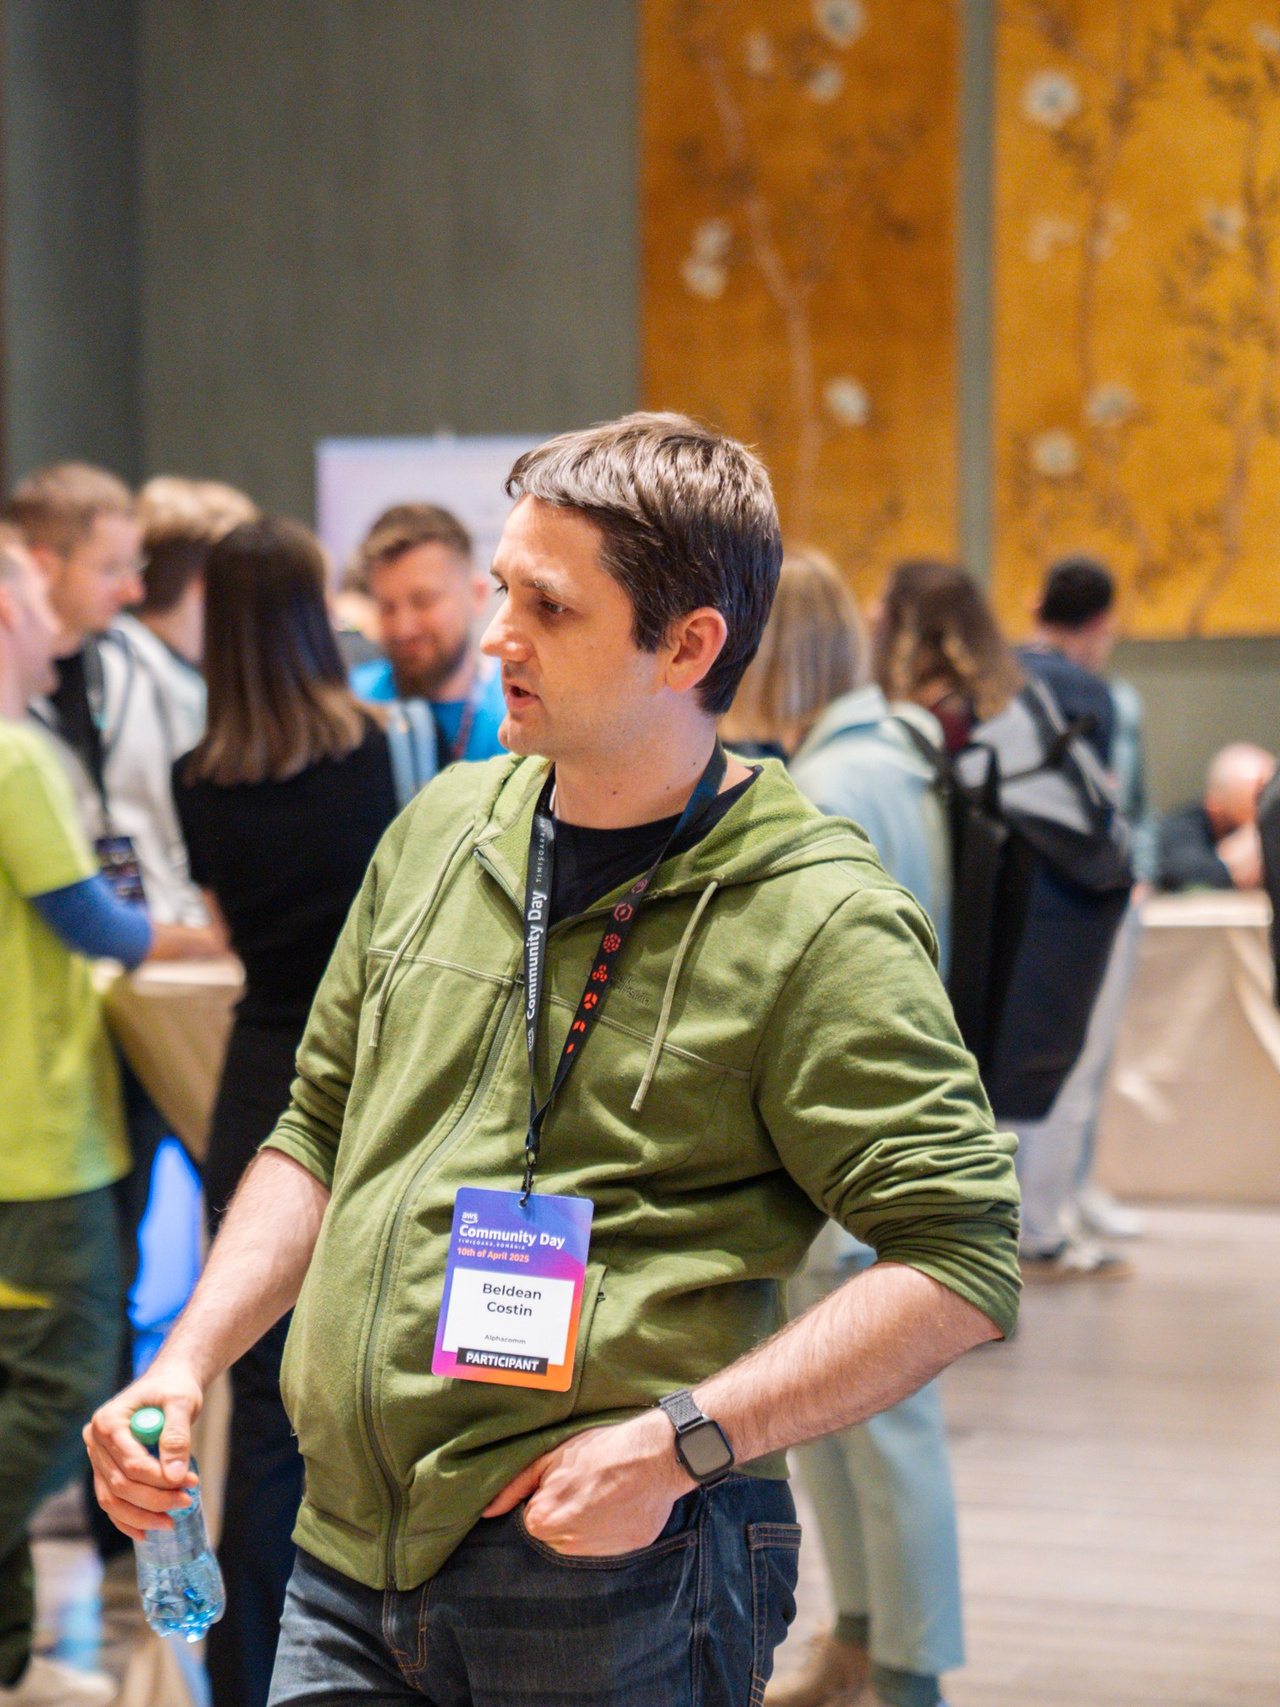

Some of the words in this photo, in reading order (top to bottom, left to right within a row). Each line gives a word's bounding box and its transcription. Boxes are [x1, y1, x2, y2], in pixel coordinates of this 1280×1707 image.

[528, 891, 548, 921] Day
[526, 925, 544, 1020] Community
[462, 1211, 478, 1221] aws
[459, 1224, 537, 1247] Community
[539, 1232, 566, 1250] Day
[457, 1247, 476, 1257] 10th
[477, 1249, 487, 1258] of
[487, 1250, 508, 1261] April
[509, 1253, 530, 1263] 2025
[482, 1283, 542, 1300] Beldean
[486, 1301, 533, 1317] Costin
[484, 1334, 527, 1344] Alphacomm
[465, 1351, 540, 1371] PARTICIPANT
